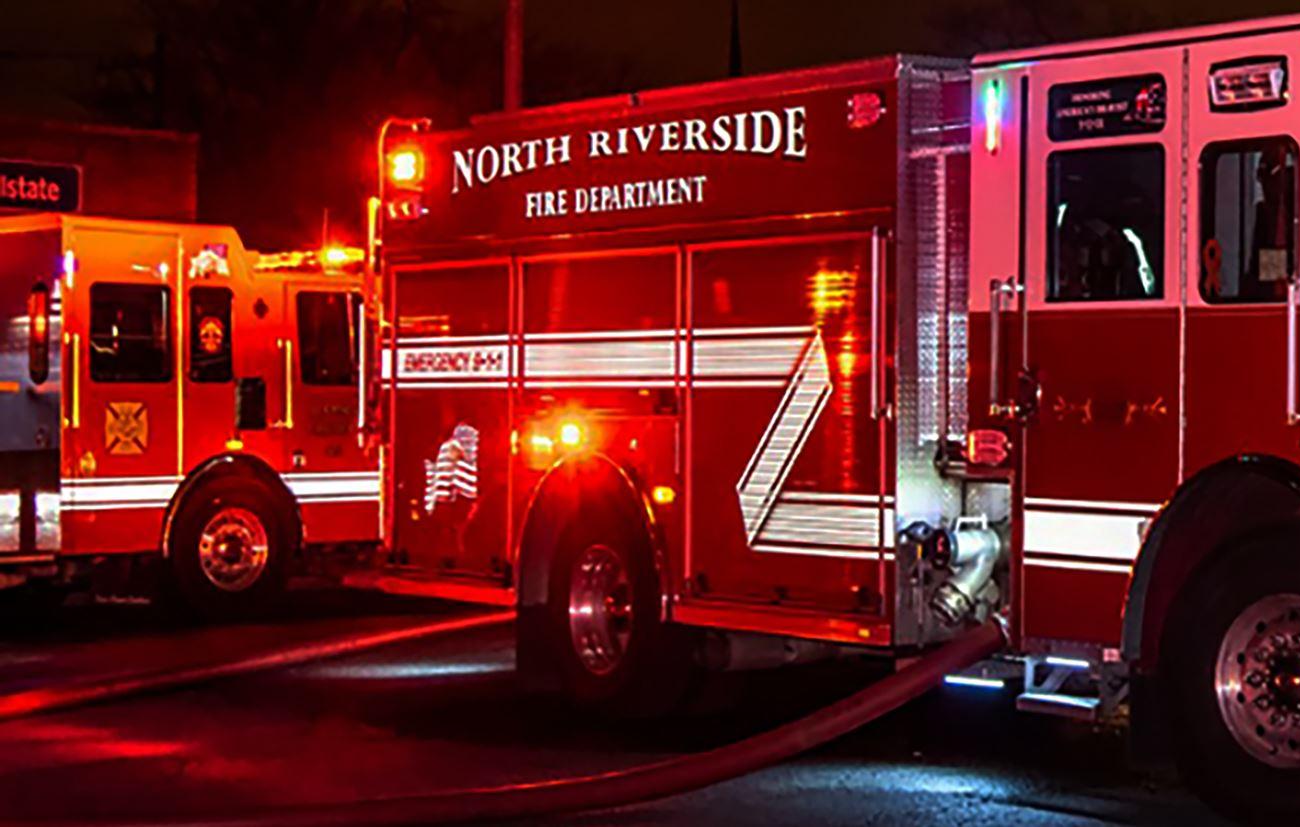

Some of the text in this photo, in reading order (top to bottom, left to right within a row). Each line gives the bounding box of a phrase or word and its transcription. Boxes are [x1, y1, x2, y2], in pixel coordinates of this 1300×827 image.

[452, 106, 808, 193] NORTH RIVERSIDE
[525, 175, 707, 218] FIRE DEPARTMENT
